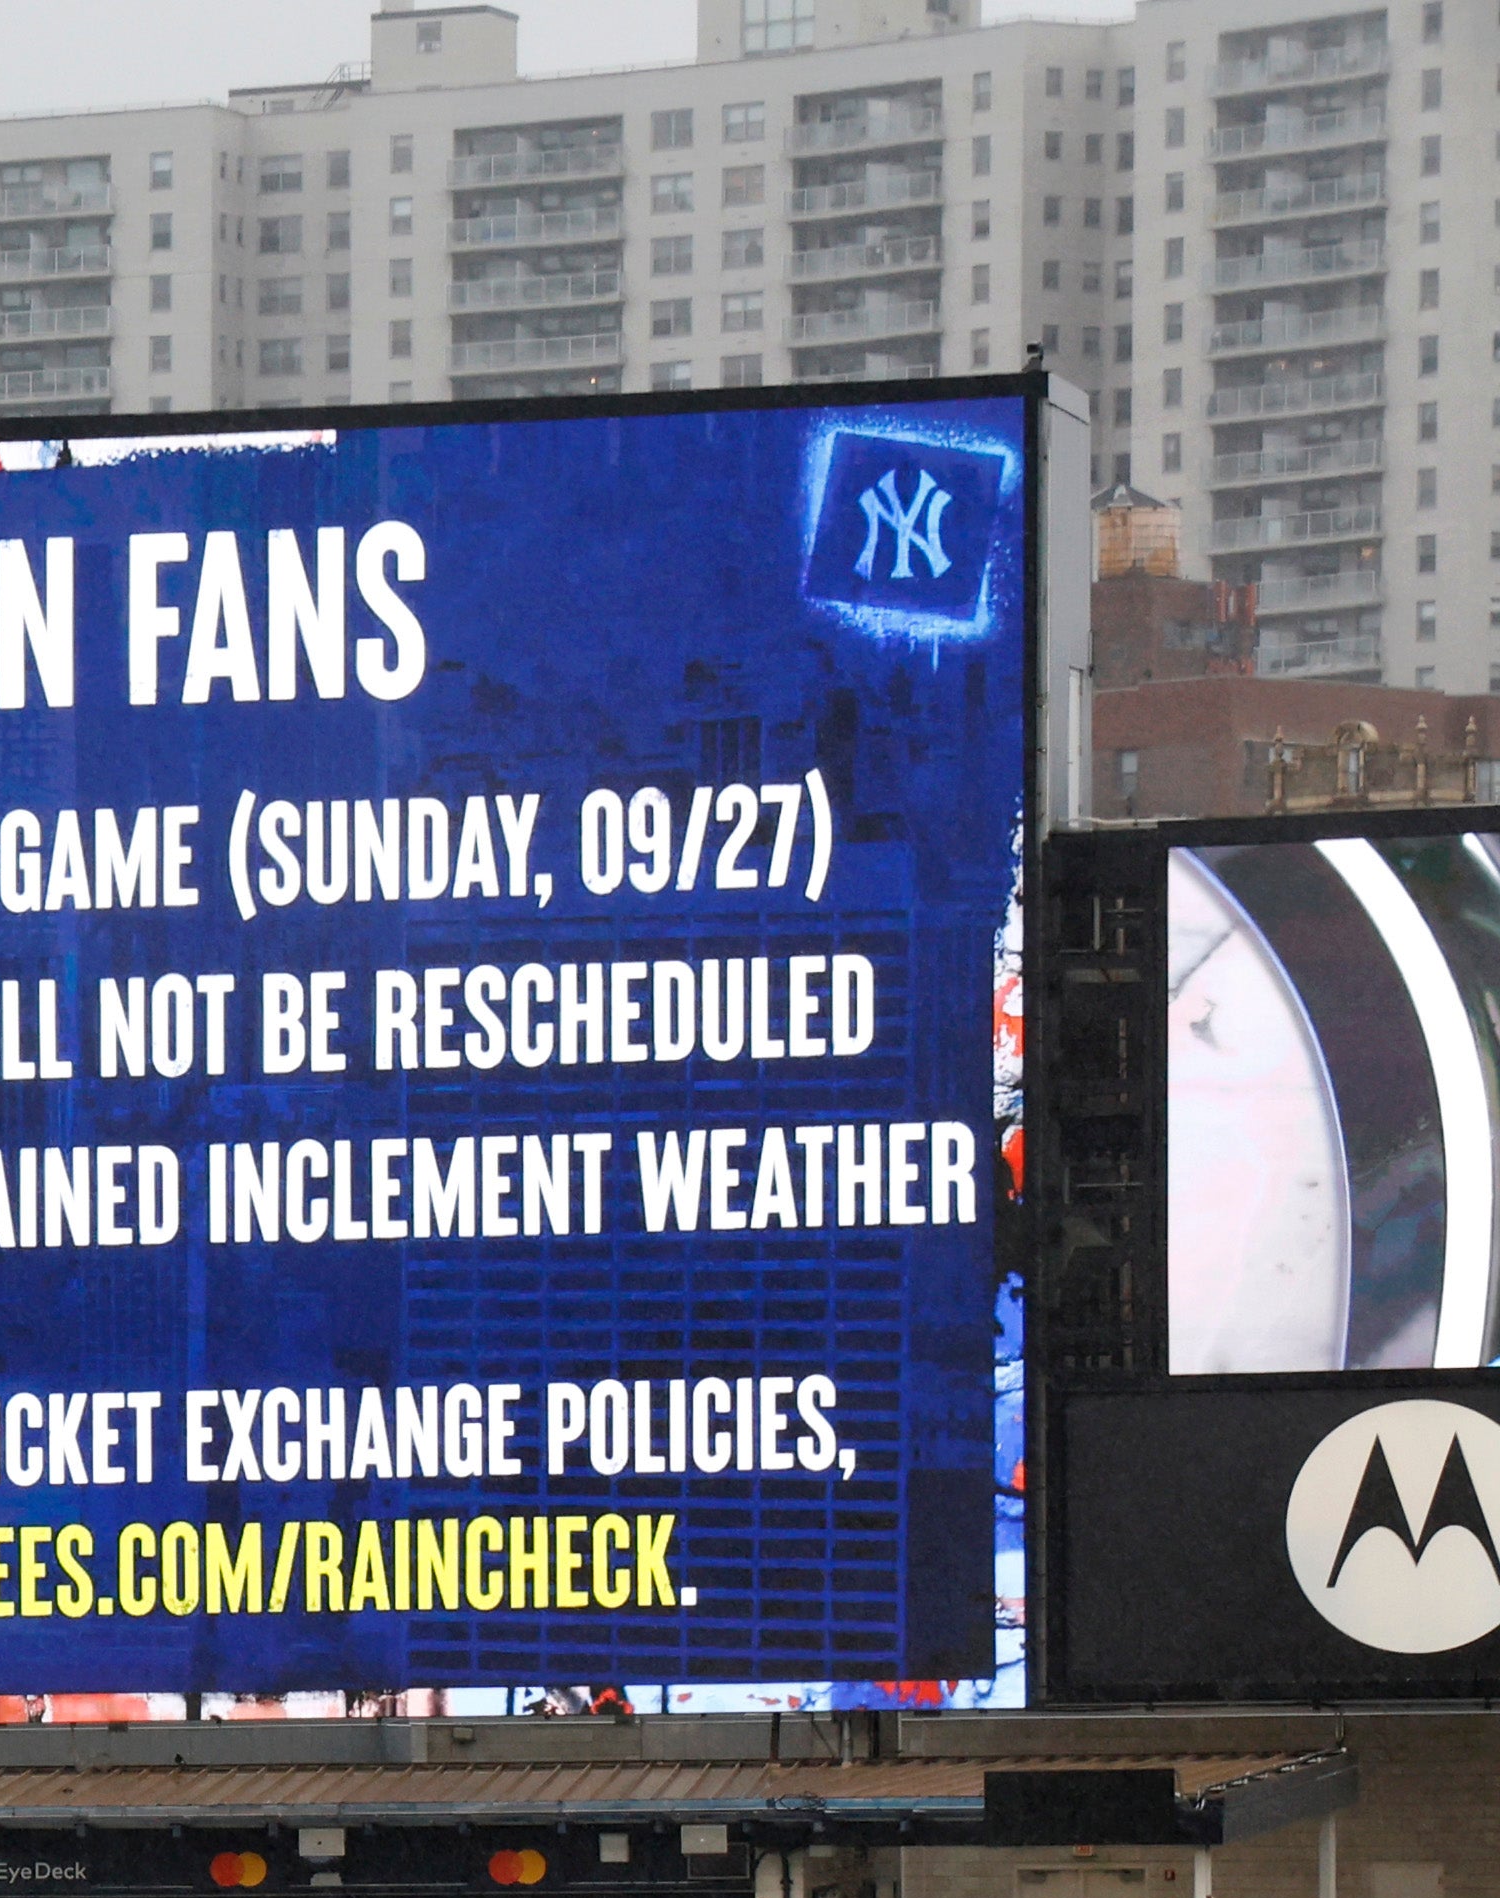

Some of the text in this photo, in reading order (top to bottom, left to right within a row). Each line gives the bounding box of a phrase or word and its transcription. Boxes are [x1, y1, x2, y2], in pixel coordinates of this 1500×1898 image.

[129, 519, 427, 707] FANS
[0, 803, 200, 916] GAME
[228, 787, 553, 922] (SUNDAY,
[580, 767, 833, 903] 09/27)
[99, 971, 236, 1080] NOT
[261, 968, 348, 1073] BE
[373, 952, 877, 1073] RESCHEDULED
[208, 1130, 614, 1248] INCLEMENT
[635, 1120, 977, 1235] WEATHER
[184, 1381, 523, 1486] EXCHANGE
[546, 1374, 858, 1484] POLICIES,
[35, 1862, 86, 1880] Deck
